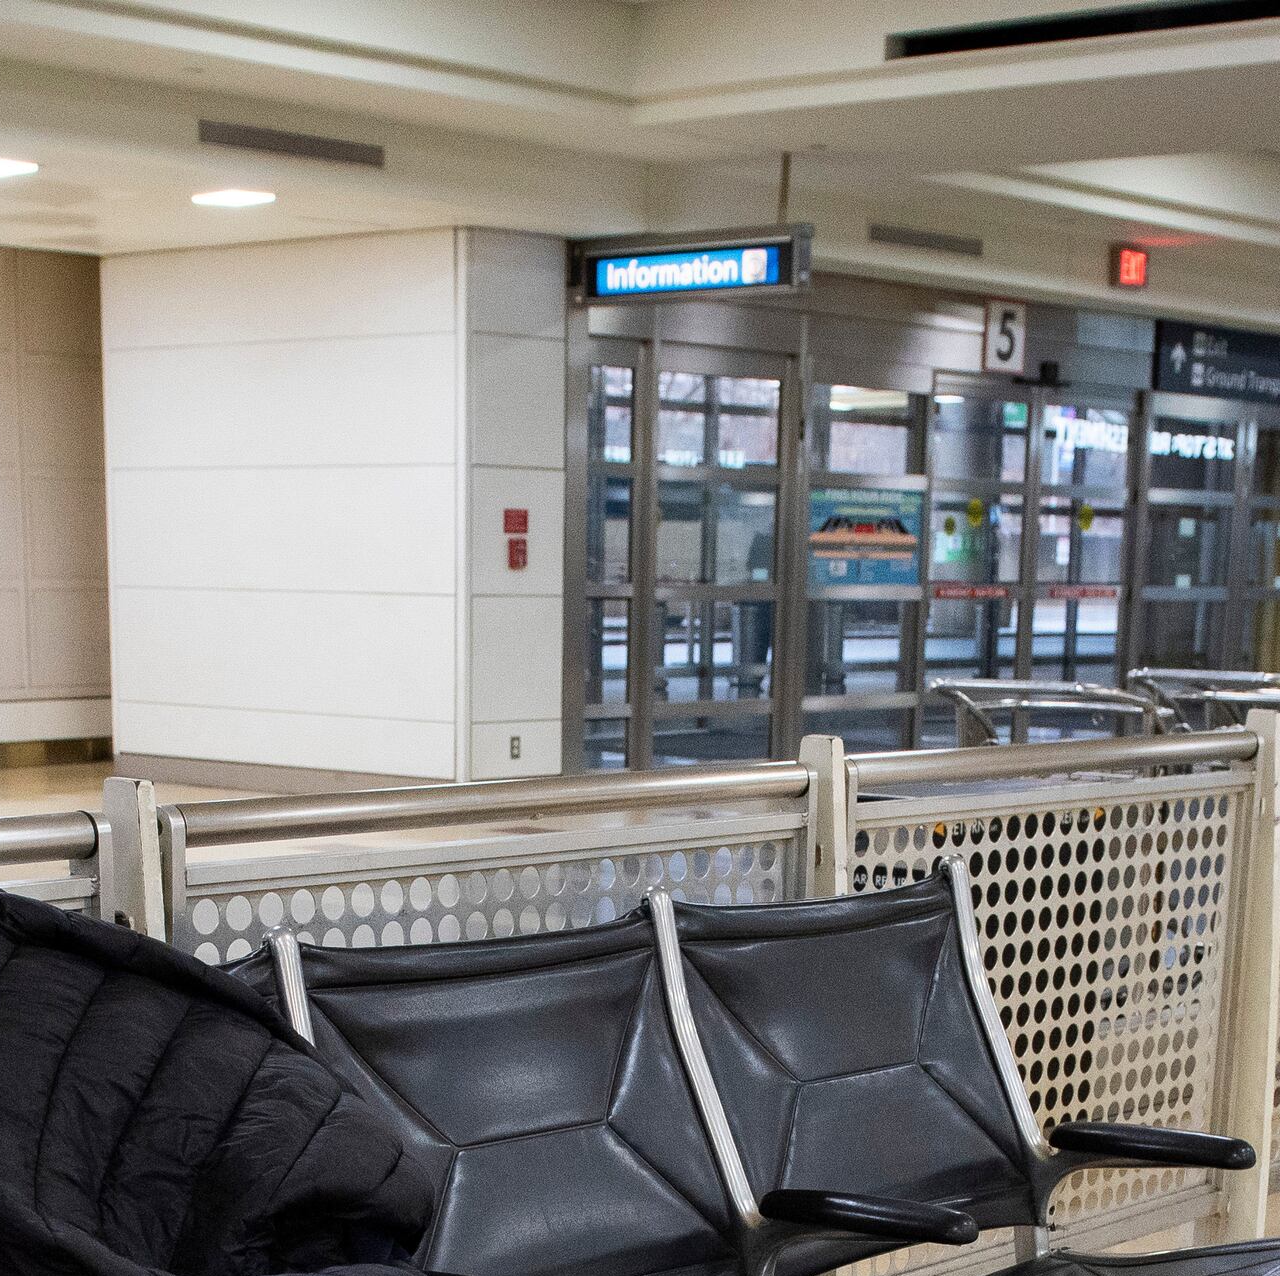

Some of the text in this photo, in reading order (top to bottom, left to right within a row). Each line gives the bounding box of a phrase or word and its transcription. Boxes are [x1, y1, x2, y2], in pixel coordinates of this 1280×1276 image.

[606, 254, 739, 292] Information
[997, 310, 1016, 362] 5
[1206, 361, 1247, 391] Ground
